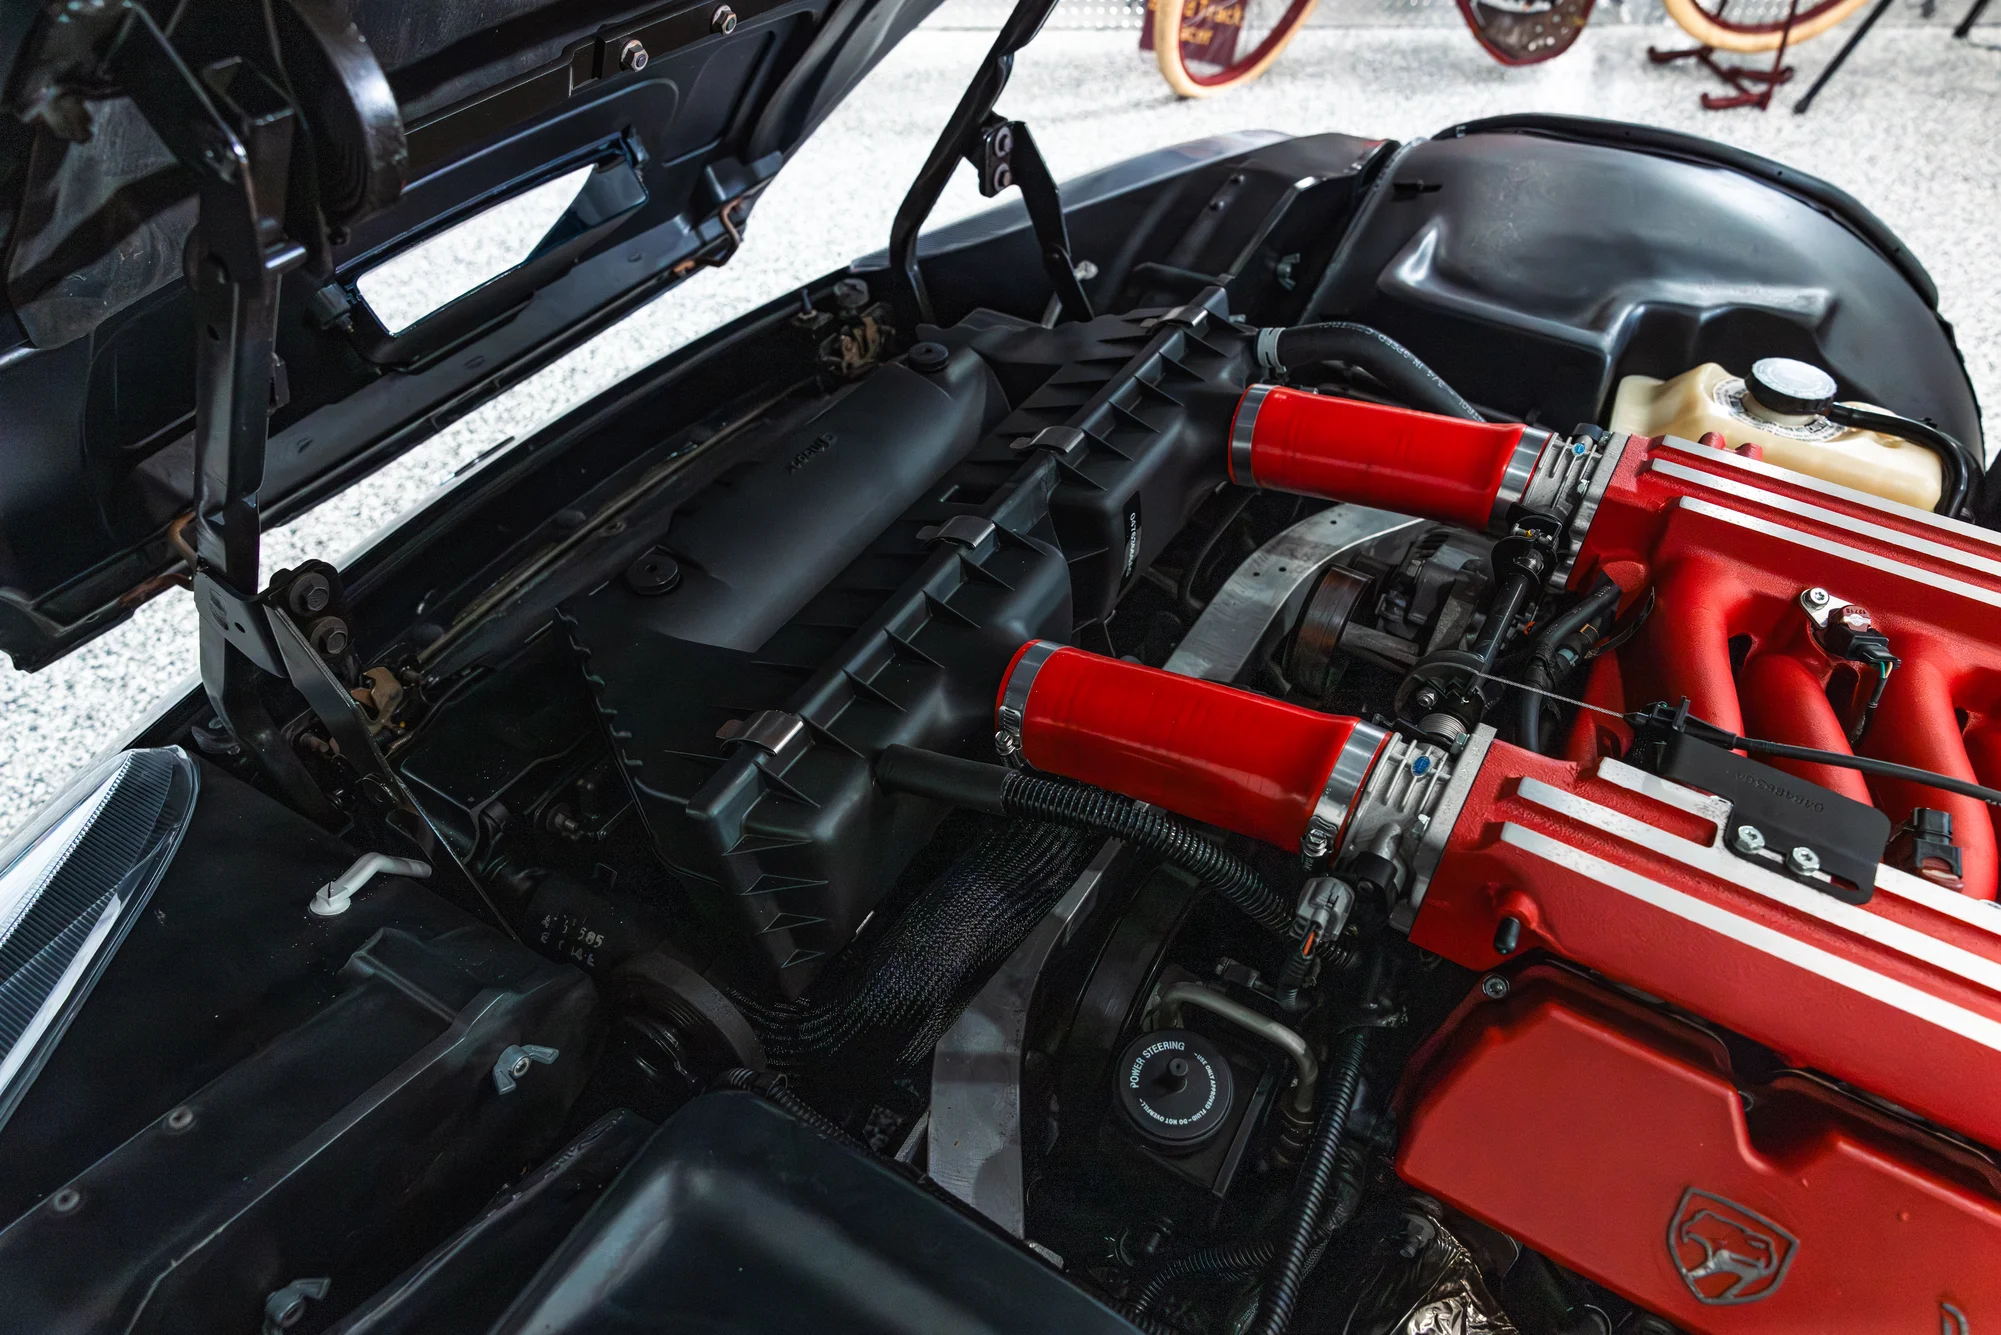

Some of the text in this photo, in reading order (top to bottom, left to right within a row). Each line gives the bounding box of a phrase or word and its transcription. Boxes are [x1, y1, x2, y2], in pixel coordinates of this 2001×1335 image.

[1129, 1040, 1186, 1089] POWER STEERING
[1205, 1064, 1215, 1079] ONLY
[1204, 1079, 1217, 1110] APPROVED
